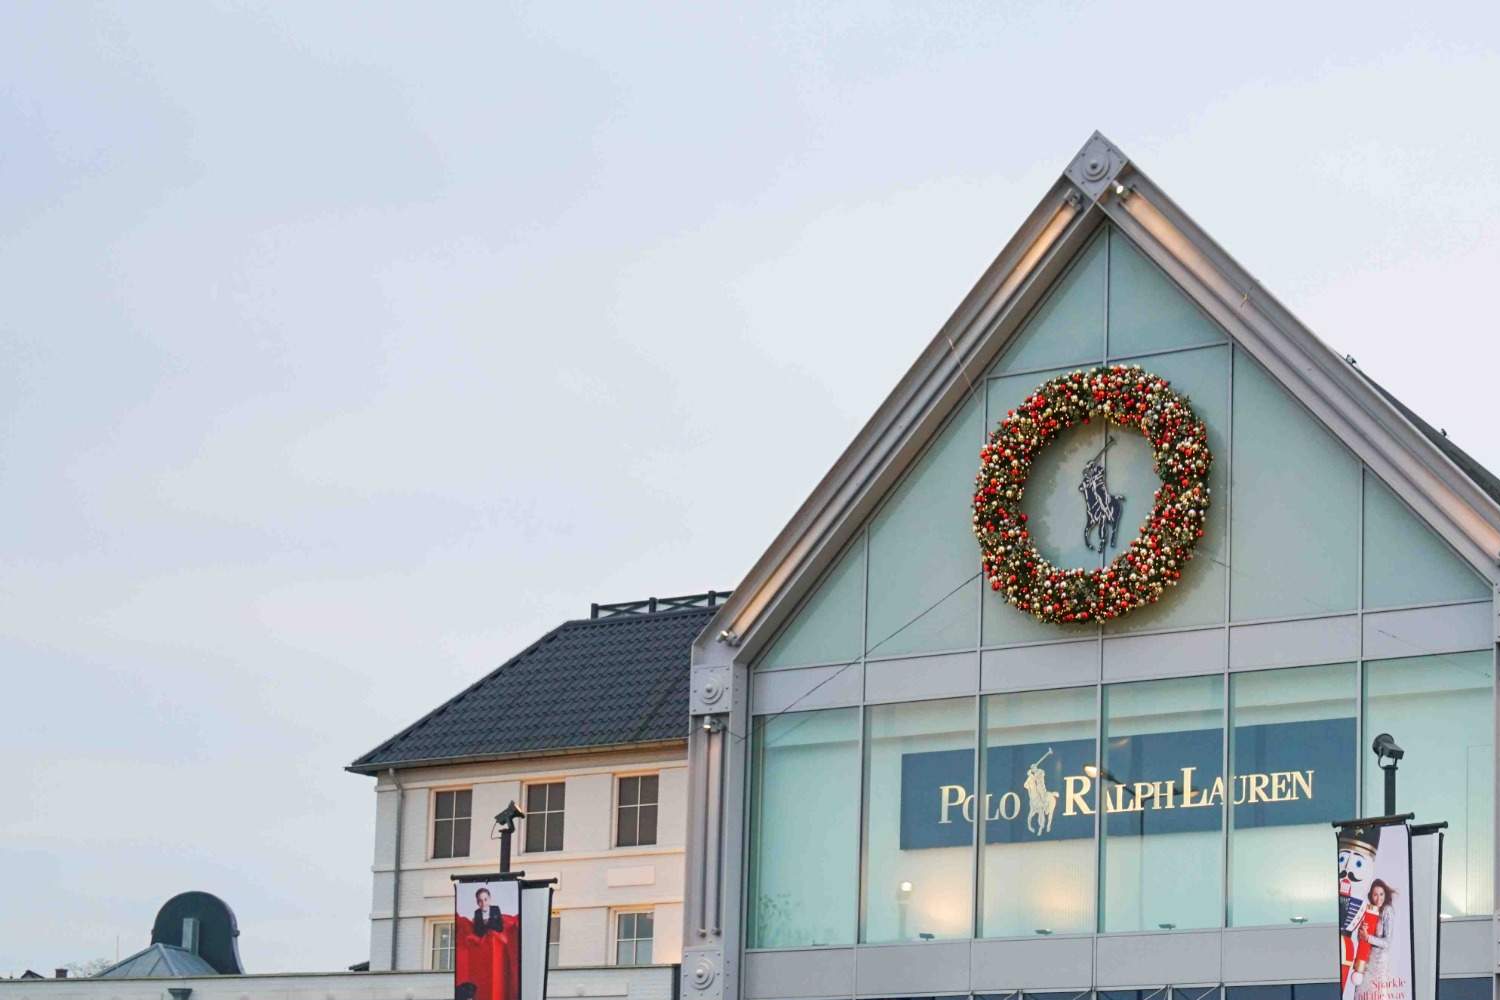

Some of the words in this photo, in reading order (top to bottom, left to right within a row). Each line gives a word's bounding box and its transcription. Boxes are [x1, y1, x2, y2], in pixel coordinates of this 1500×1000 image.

[938, 784, 1020, 824] POLO
[1062, 774, 1175, 816] RALPH
[1180, 766, 1315, 808] LAUREN
[1372, 976, 1406, 991] Sparkle
